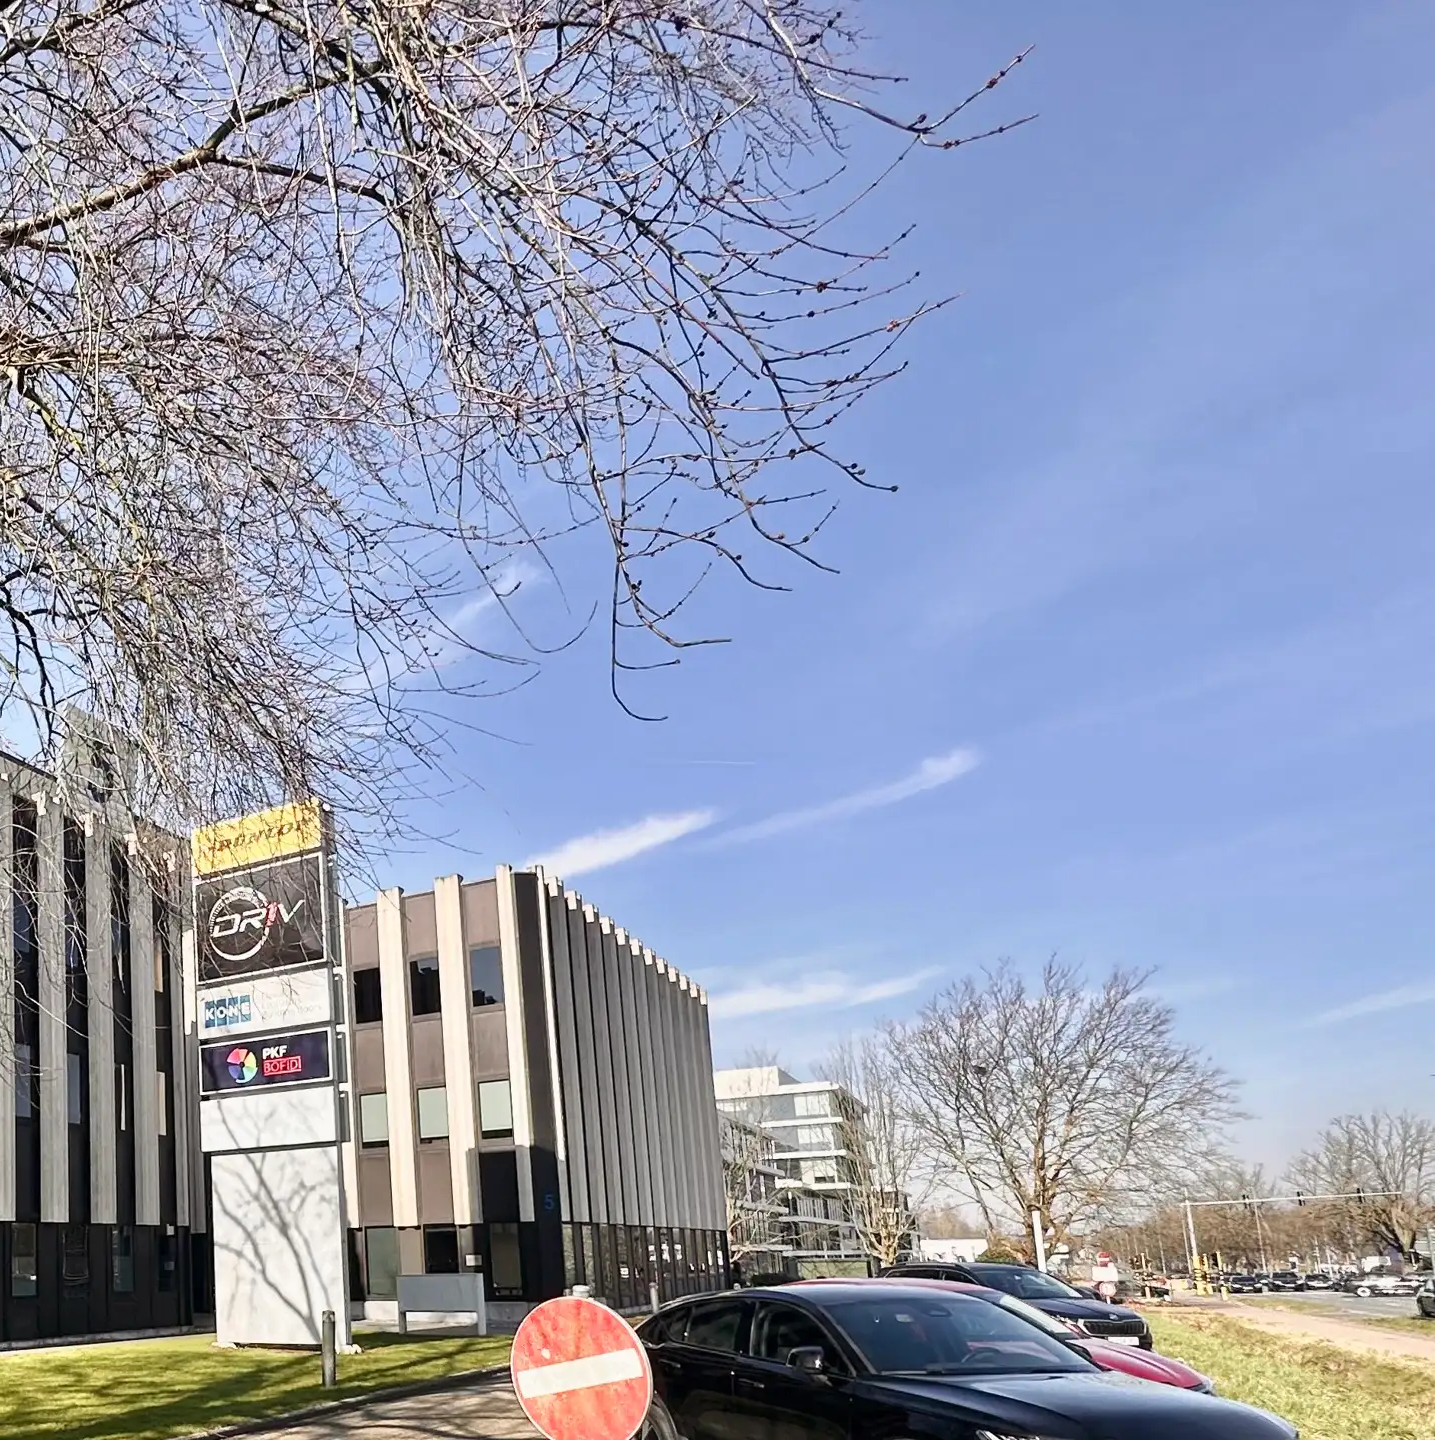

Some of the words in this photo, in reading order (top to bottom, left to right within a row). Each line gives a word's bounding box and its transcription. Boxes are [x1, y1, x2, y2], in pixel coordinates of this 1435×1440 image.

[205, 1002, 251, 1021] KONE
[262, 1045, 287, 1060] PKF
[544, 1194, 555, 1210] 5
